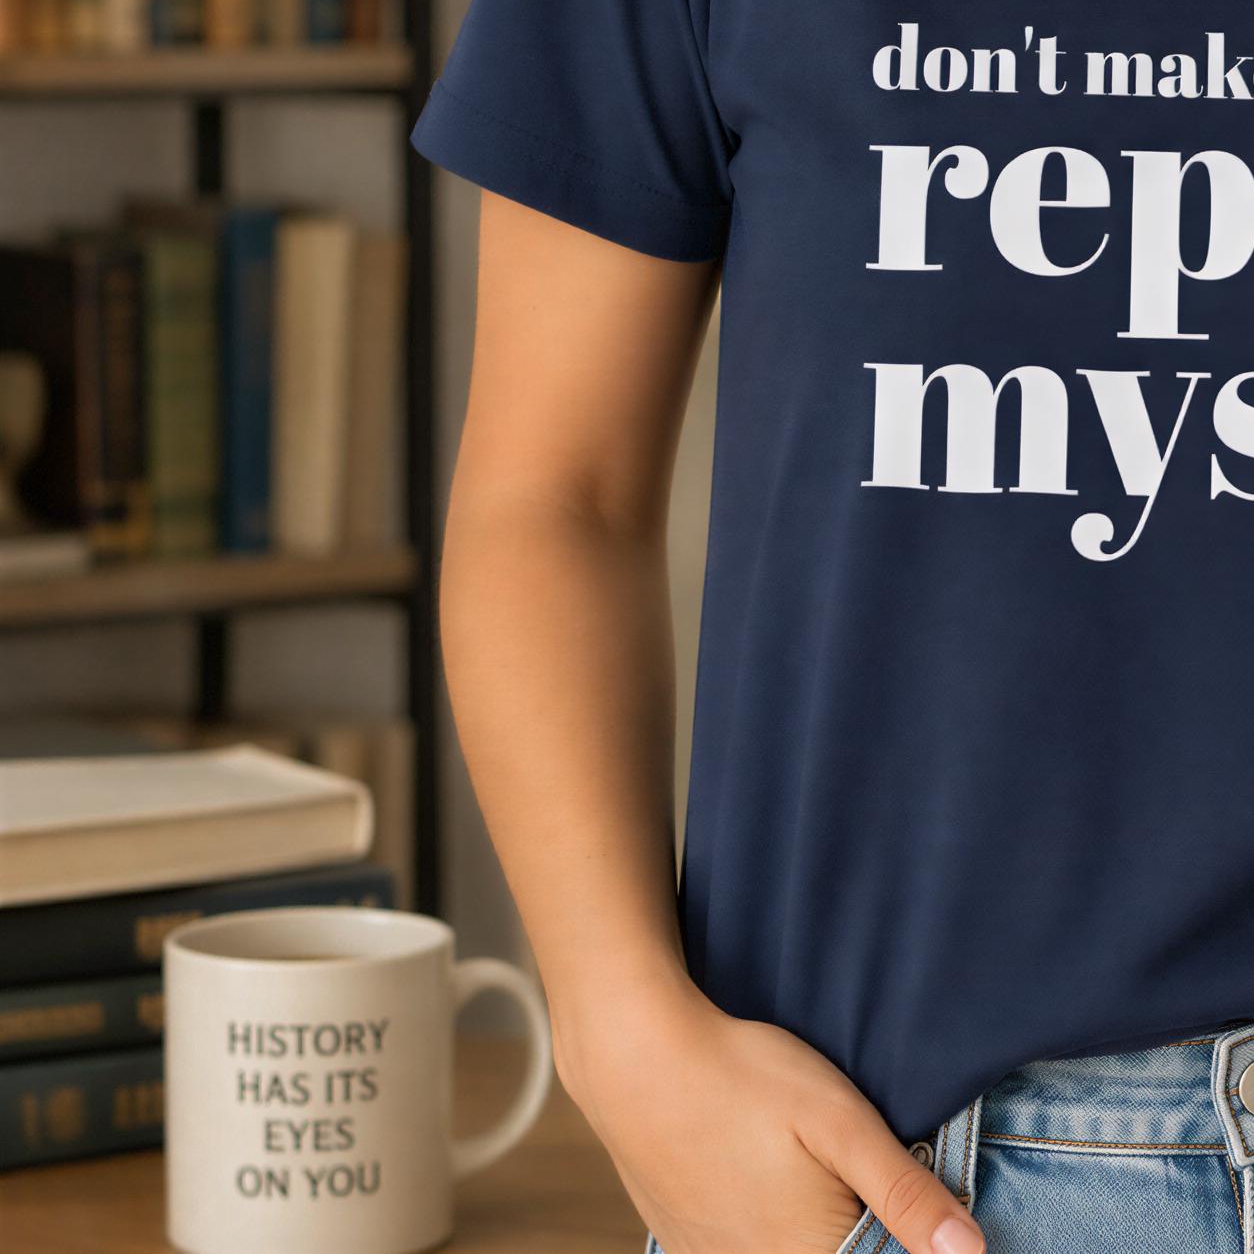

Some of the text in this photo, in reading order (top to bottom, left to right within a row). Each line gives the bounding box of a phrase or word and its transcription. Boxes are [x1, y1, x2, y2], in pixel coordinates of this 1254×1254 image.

[873, 23, 1066, 95] don't
[227, 1018, 390, 1058] HISTORY
[237, 1068, 378, 1105] HAS ITS
[263, 1117, 356, 1153] EYES
[236, 1161, 381, 1198] ON YOU
